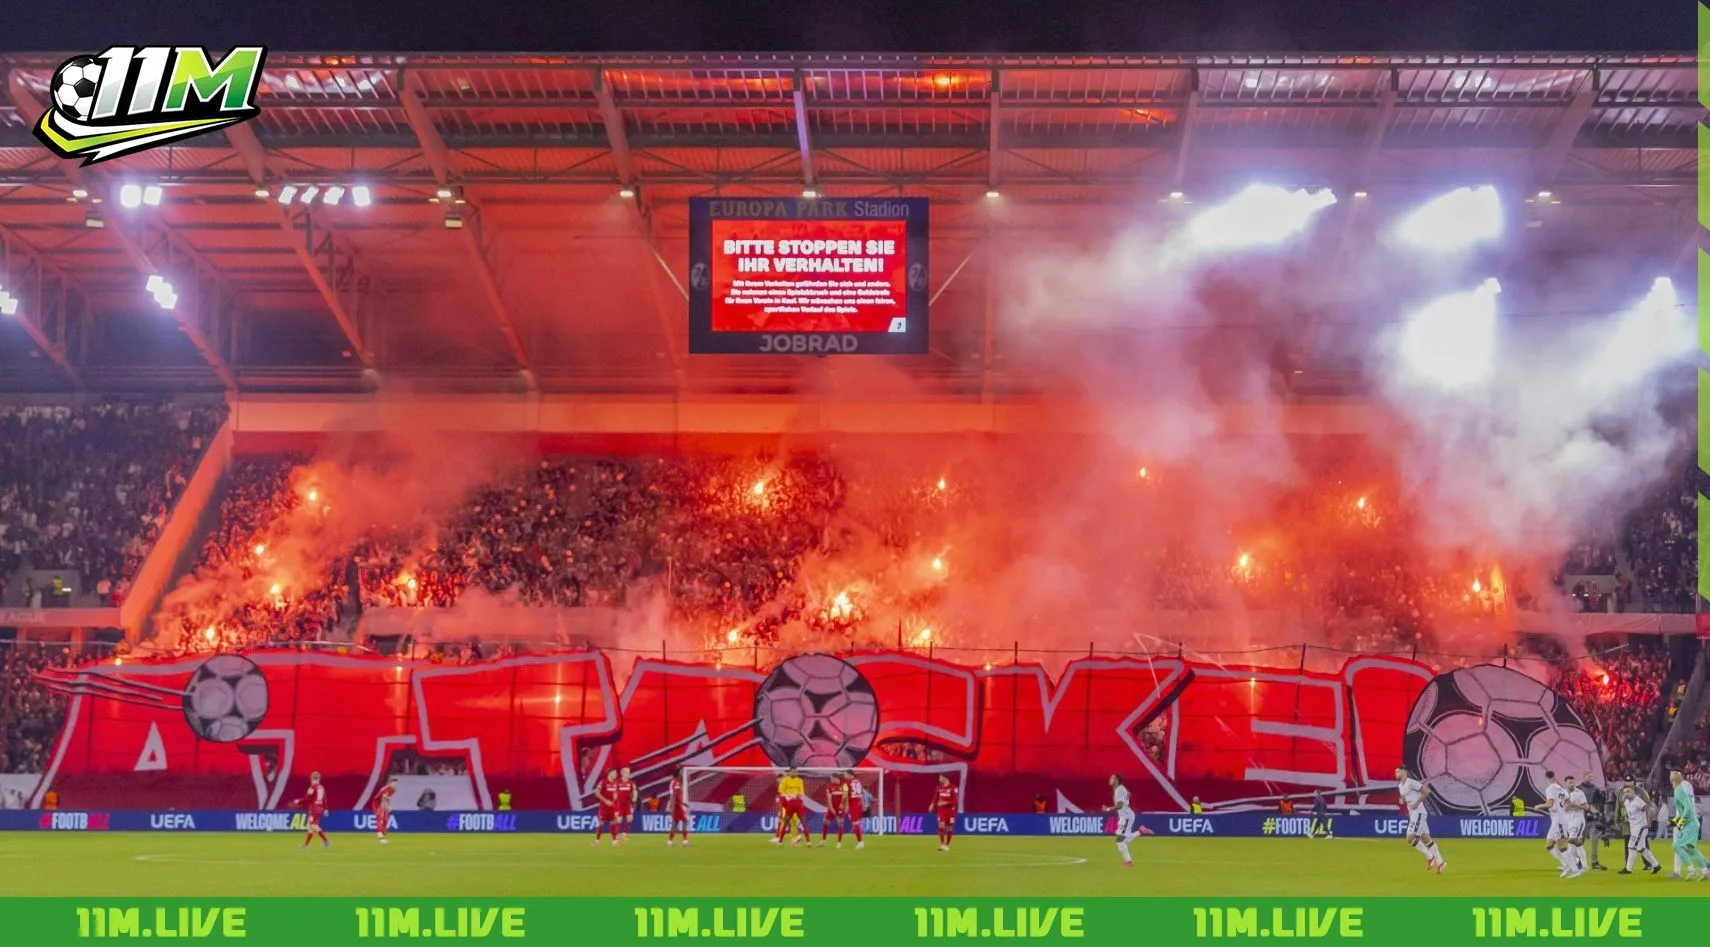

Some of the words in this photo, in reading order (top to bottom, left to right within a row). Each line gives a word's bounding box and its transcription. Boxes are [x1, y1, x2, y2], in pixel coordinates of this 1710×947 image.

[710, 201, 788, 217] EUROPA
[797, 201, 848, 217] PARK
[854, 201, 910, 217] Stadion
[723, 240, 775, 255] BITTE
[778, 240, 862, 255] STOPPEN
[866, 240, 895, 255] SIE
[738, 258, 770, 273] IHR
[774, 258, 884, 273] VERHALTEN!
[760, 335, 858, 352] JOBRAD
[39, 813, 110, 831] #FOOTBALL
[150, 814, 195, 828] UEFA
[235, 813, 289, 831] WELCOME
[290, 813, 309, 830] AL
[354, 814, 398, 829] UEA
[446, 814, 517, 831] #FOOTBALL
[557, 815, 601, 829] UEFA
[642, 815, 696, 832] WELCE
[697, 815, 720, 831] ALL
[964, 817, 1009, 832] UEFA
[1050, 816, 1103, 833] WELCOME
[1169, 818, 1214, 833] UEFA
[1374, 819, 1408, 834] UEF
[1460, 818, 1514, 836] WELCOME
[1515, 819, 1539, 836] ALL
